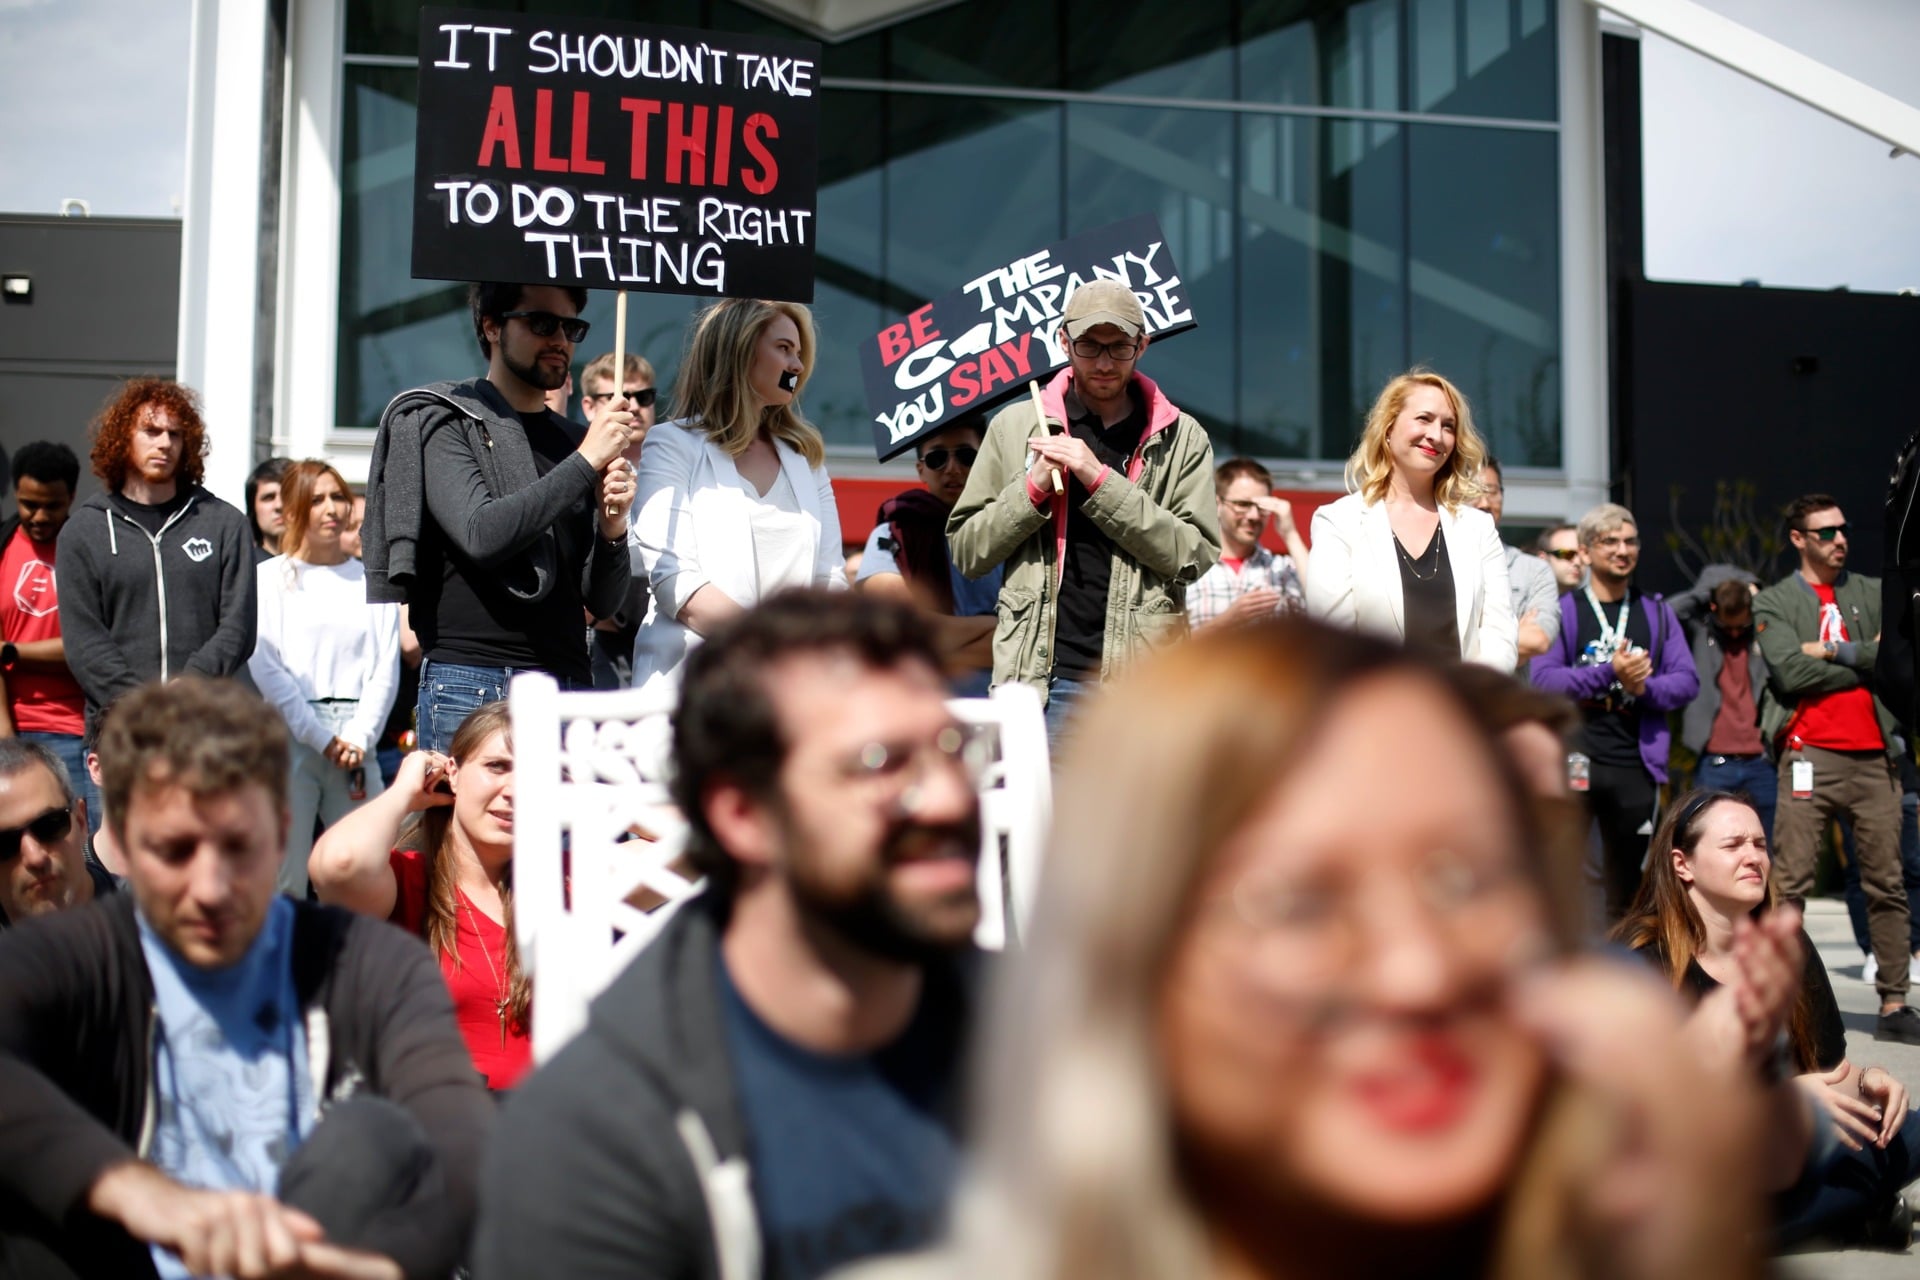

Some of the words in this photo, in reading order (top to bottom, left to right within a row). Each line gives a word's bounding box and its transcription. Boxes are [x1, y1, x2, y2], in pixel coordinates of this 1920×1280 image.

[434, 23, 512, 72] IT
[529, 30, 728, 85] SHOULDN'T
[736, 53, 814, 97] TAKE
[477, 85, 606, 175] ALL
[620, 97, 780, 195] THIS
[434, 181, 500, 224] TO
[511, 183, 575, 228] DO
[583, 193, 681, 233] THE
[698, 197, 812, 247] RIGHT
[524, 231, 725, 293] THING
[877, 303, 941, 368] BE
[962, 249, 1066, 313] THE
[874, 381, 945, 445] YOU
[948, 332, 1032, 407] SAY
